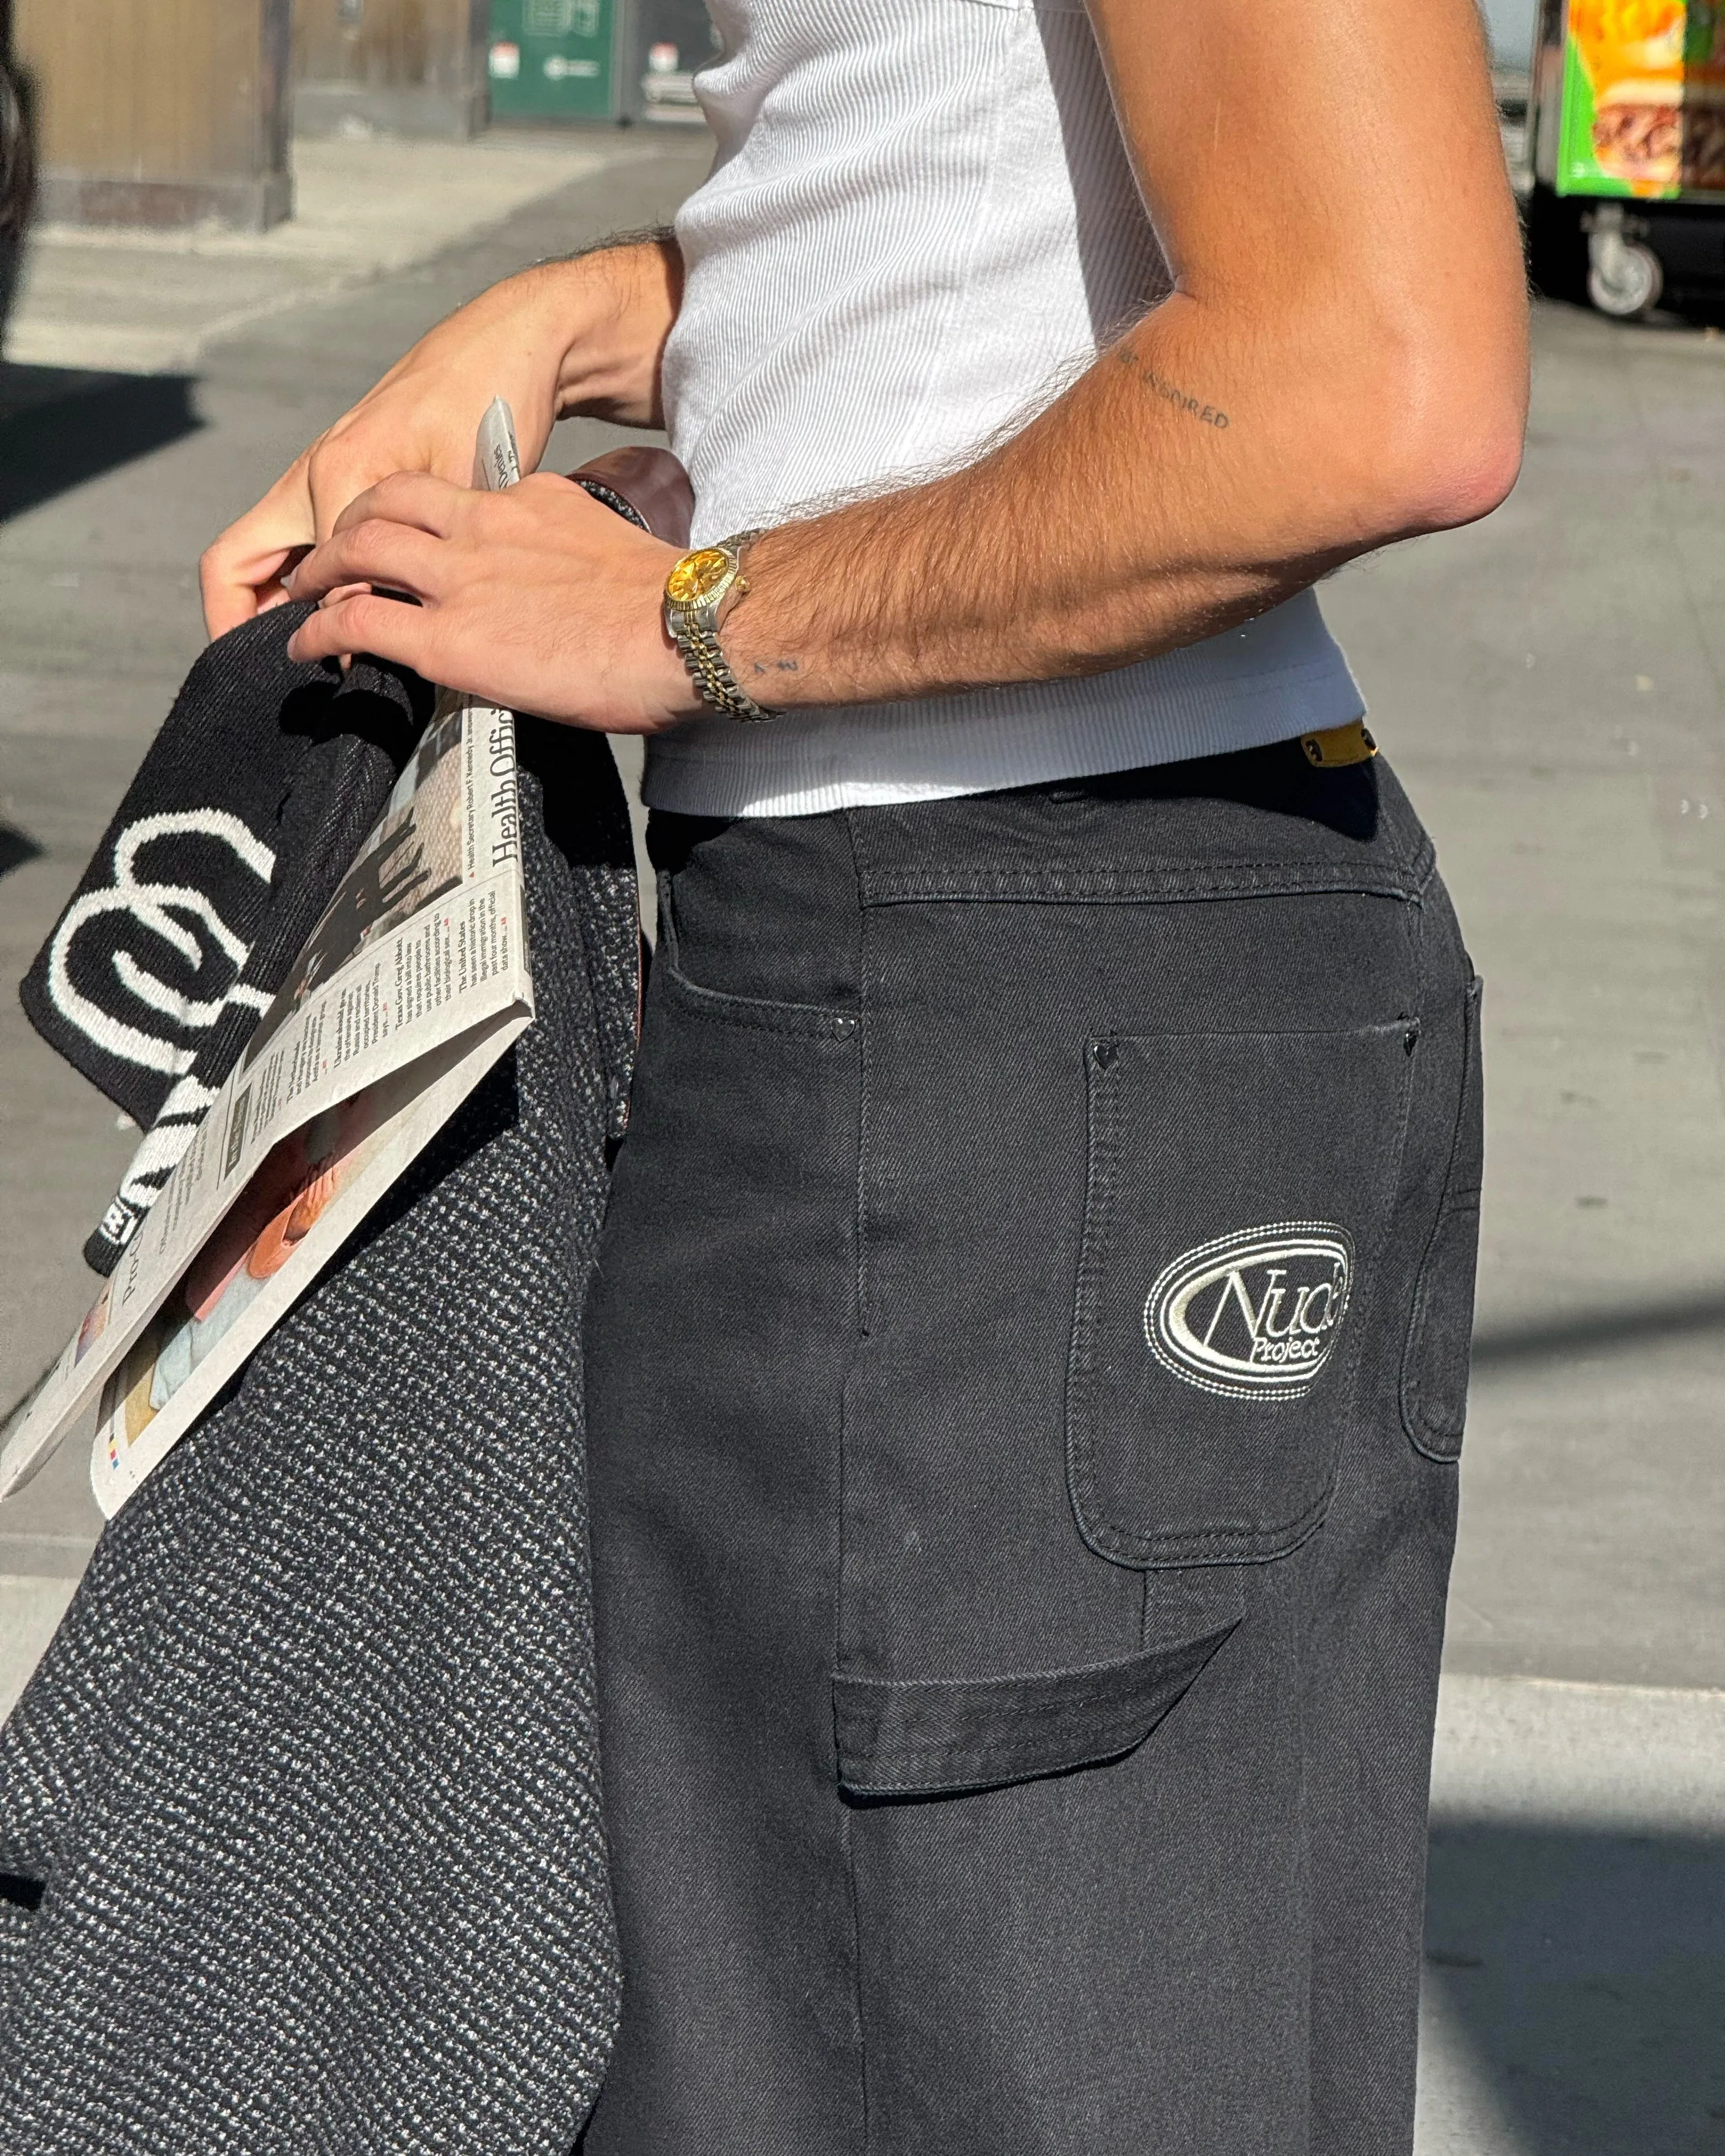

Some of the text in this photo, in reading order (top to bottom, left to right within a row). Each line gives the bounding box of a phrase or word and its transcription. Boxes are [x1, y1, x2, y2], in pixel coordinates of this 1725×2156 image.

[467, 809, 475, 844] Secretary
[491, 779, 517, 867] Health
[434, 913, 439, 922] to
[479, 910, 485, 919] in
[415, 940, 421, 949] to
[433, 920, 442, 956] according
[479, 918, 488, 961] immigration
[395, 964, 404, 986] Greg
[443, 949, 452, 984] biological
[406, 986, 414, 1010] signed
[424, 976, 433, 998] public
[1250, 1336, 1319, 1363] Project
